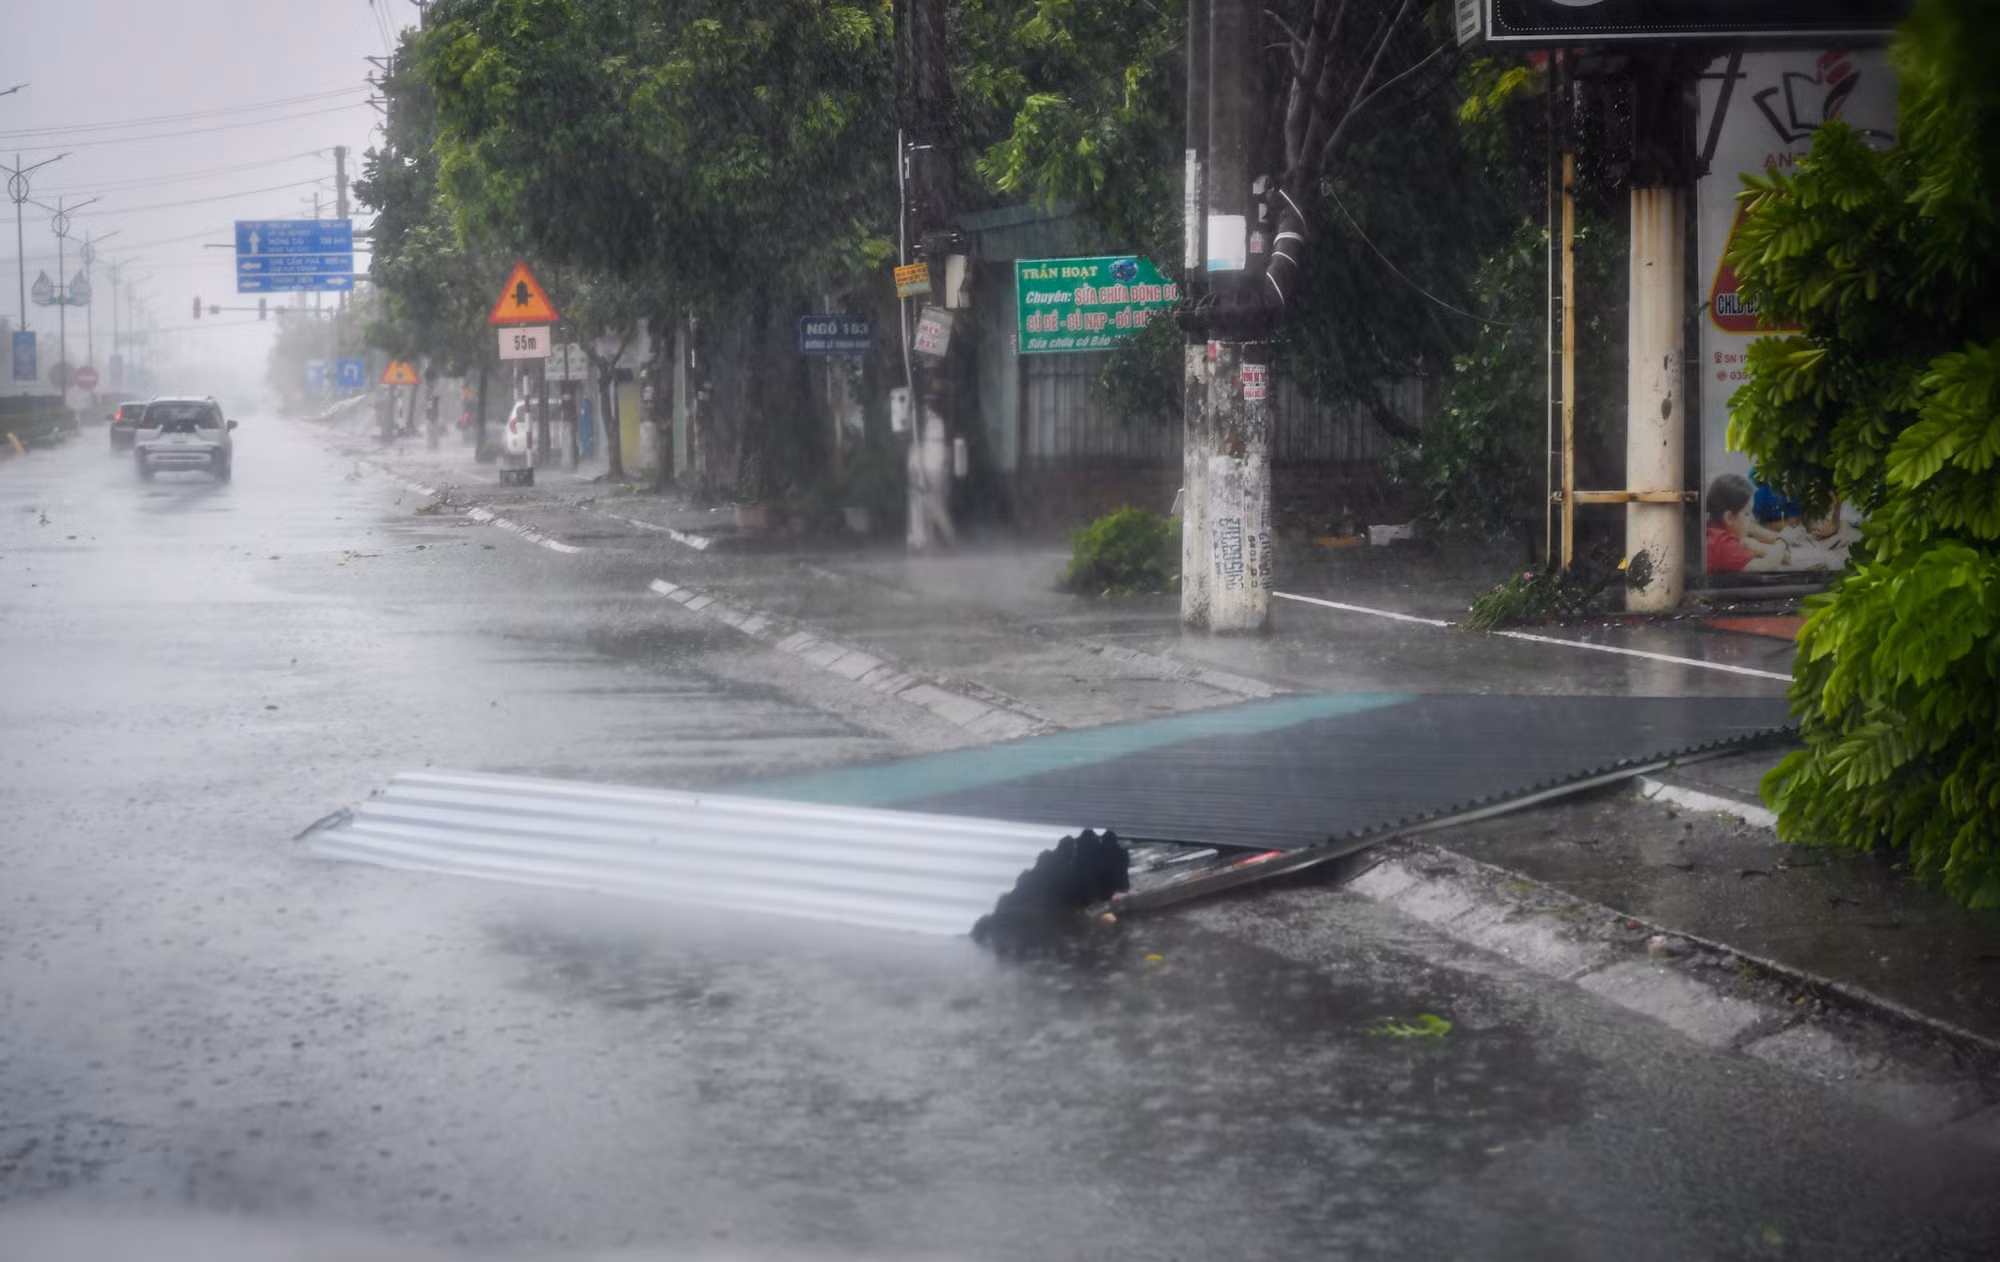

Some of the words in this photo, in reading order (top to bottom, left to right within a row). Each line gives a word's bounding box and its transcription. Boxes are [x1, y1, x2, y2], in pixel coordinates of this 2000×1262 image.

[1061, 265, 1099, 280] HOẠT
[1026, 290, 1072, 304] Chuyên:
[1074, 282, 1098, 305] SỬA
[1099, 282, 1130, 304] CHỮA
[1130, 281, 1162, 306] ĐỘNG
[1084, 311, 1108, 333] NẠP
[514, 335, 537, 350] 55m
[1724, 354, 1736, 364] SN
